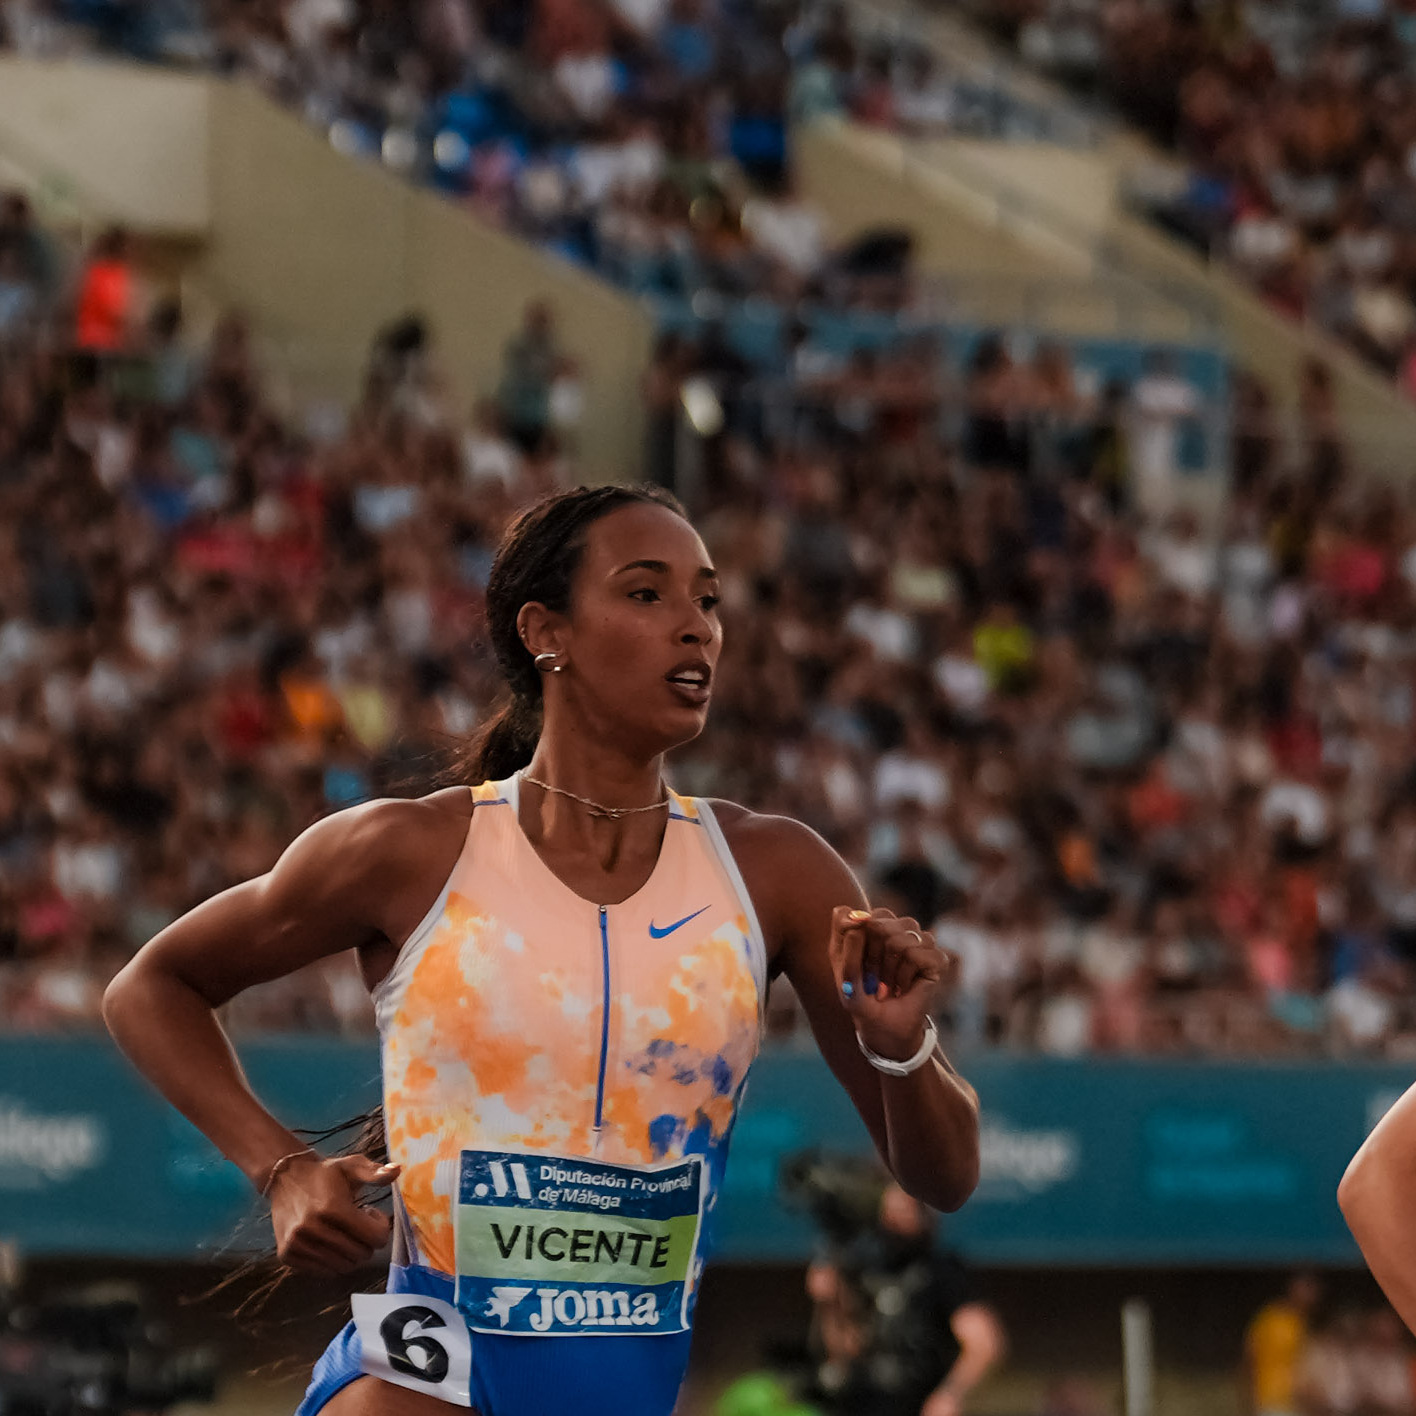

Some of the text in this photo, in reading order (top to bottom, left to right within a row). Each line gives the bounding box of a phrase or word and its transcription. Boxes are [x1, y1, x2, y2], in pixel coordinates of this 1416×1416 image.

[539, 1164, 692, 1194] Diputación Provincial
[538, 1187, 621, 1209] de Málaga
[489, 1223, 671, 1268] VICENTE
[379, 1305, 450, 1384] 6
